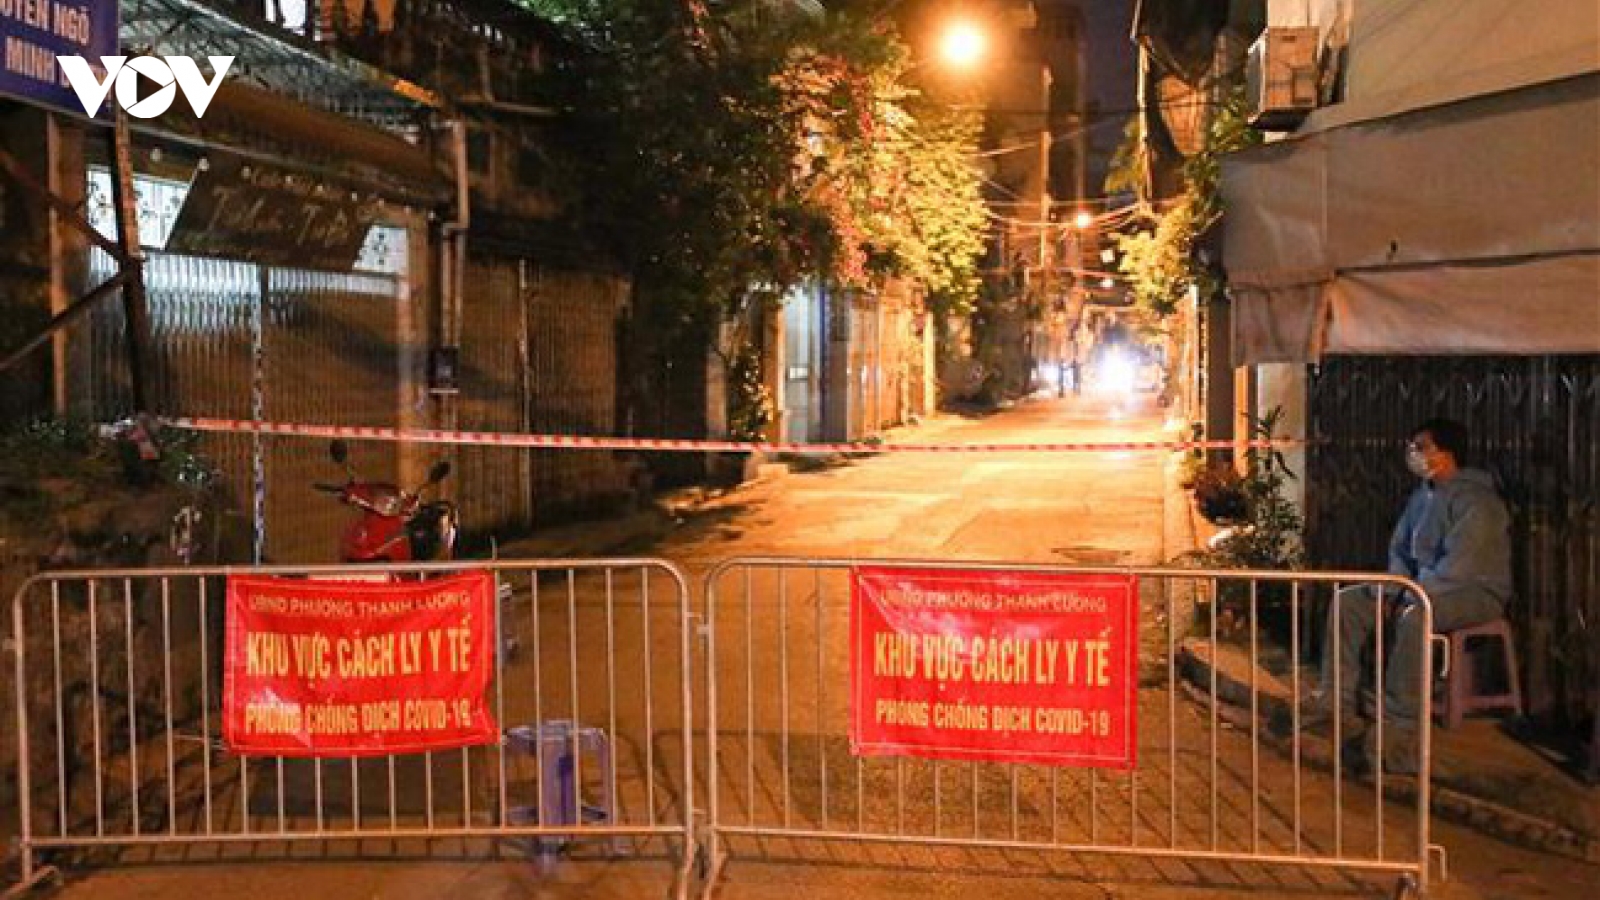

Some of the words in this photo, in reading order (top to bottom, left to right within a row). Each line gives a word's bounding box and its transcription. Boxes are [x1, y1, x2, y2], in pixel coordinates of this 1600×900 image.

[246, 631, 289, 677] KHU
[292, 631, 331, 689] VỰC
[336, 629, 395, 679] CÁCH
[400, 631, 421, 675] LY
[428, 628, 442, 672] Y
[447, 612, 473, 672] TẾ
[874, 631, 918, 678] KHU
[922, 632, 964, 691] VỰC
[971, 628, 1030, 683] CÁCH
[1035, 638, 1059, 685] LY
[1065, 638, 1079, 685] Y
[1085, 625, 1112, 687] TẾ
[361, 700, 400, 739] DỊCH
[404, 698, 471, 731] COVID-19
[992, 704, 1032, 738] DỊCH
[1035, 706, 1110, 737] COVID-19
